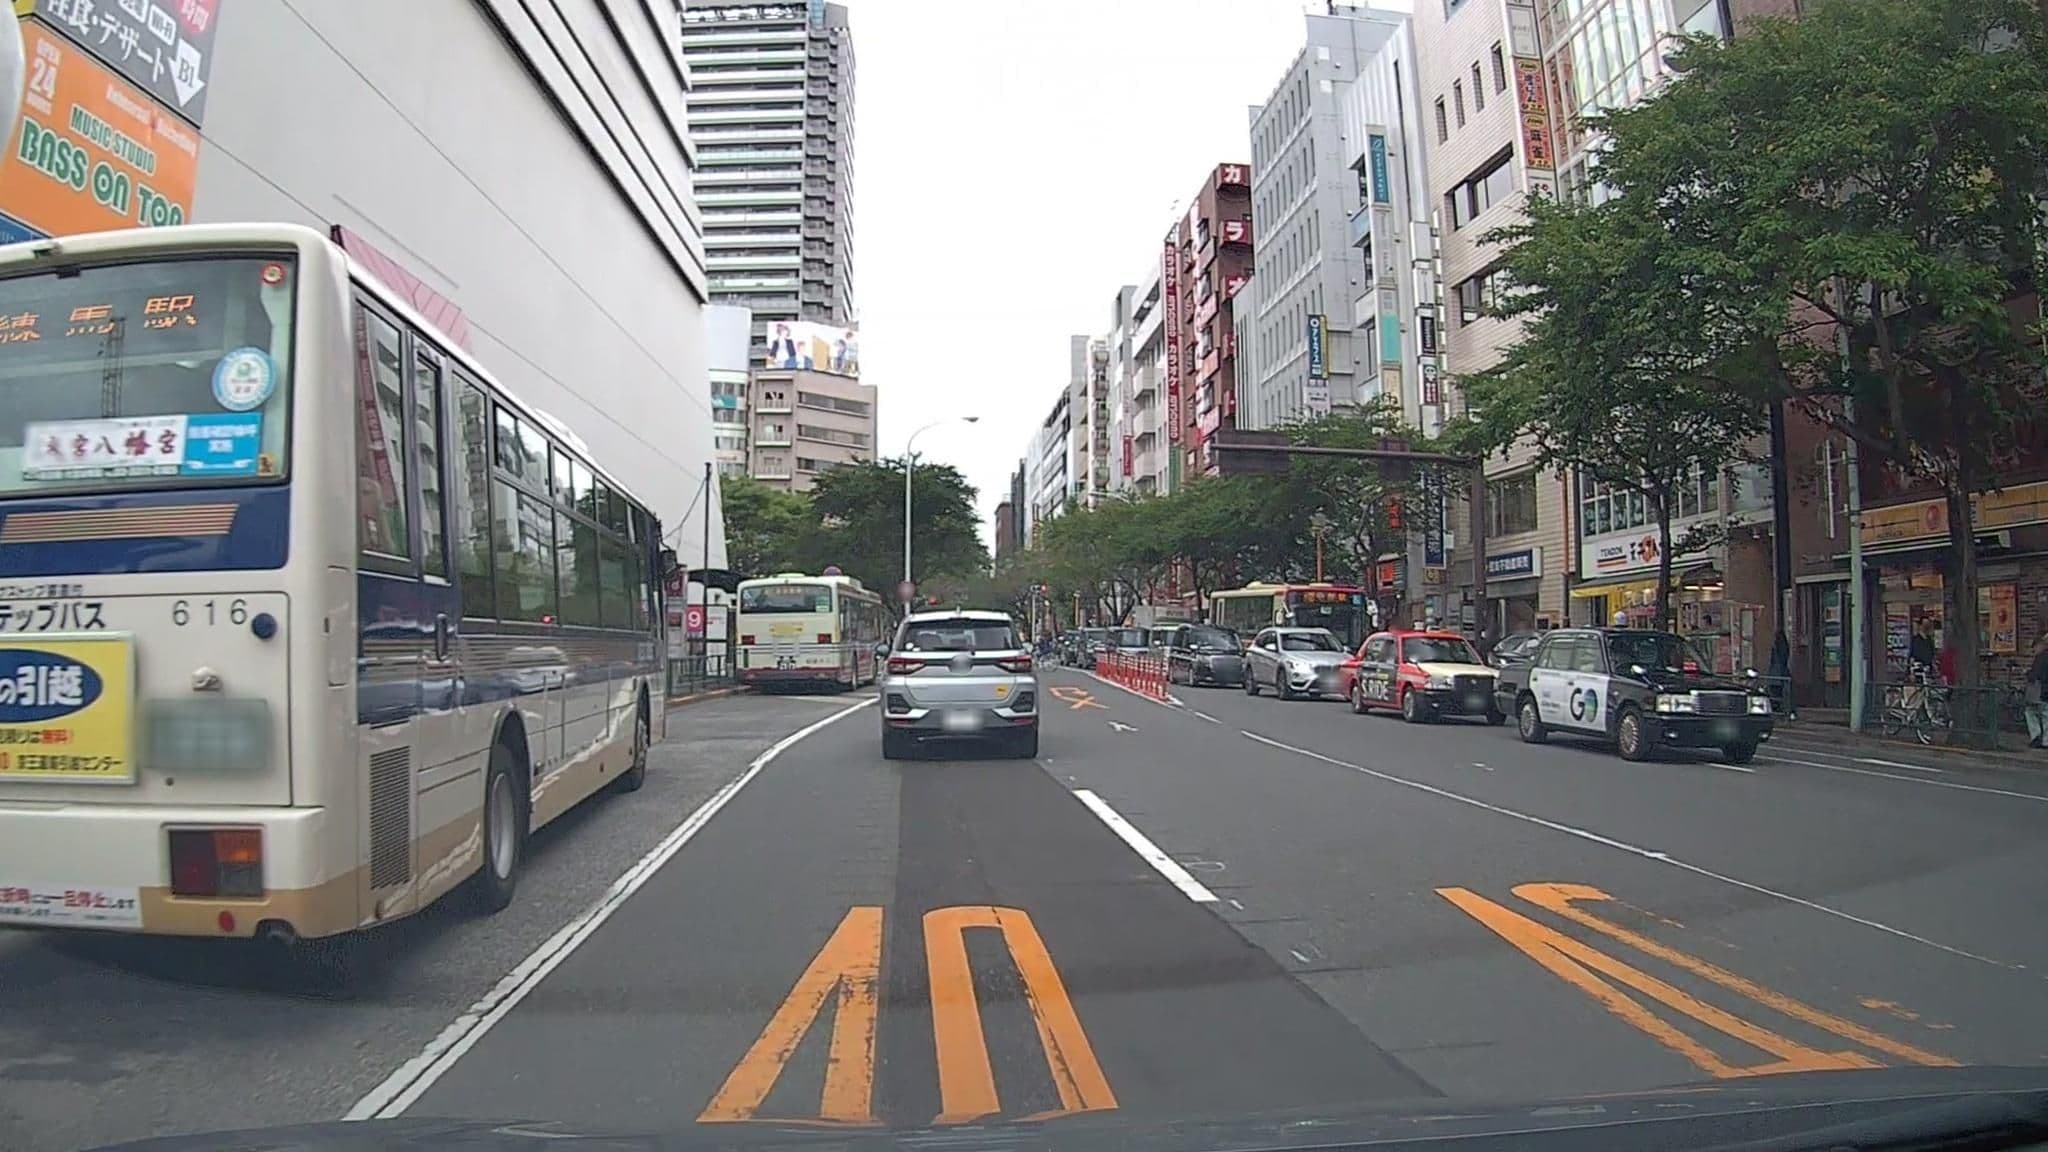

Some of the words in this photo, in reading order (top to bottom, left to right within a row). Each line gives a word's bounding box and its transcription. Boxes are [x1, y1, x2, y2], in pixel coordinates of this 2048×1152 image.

[31, 57, 57, 100] 24
[178, 57, 195, 89] B1
[16, 116, 89, 193] BASS
[69, 103, 112, 149] MUSIC
[112, 131, 157, 177] STUDIO
[172, 598, 249, 628] 616
[687, 610, 702, 628] 9
[1569, 687, 1598, 723] GO
